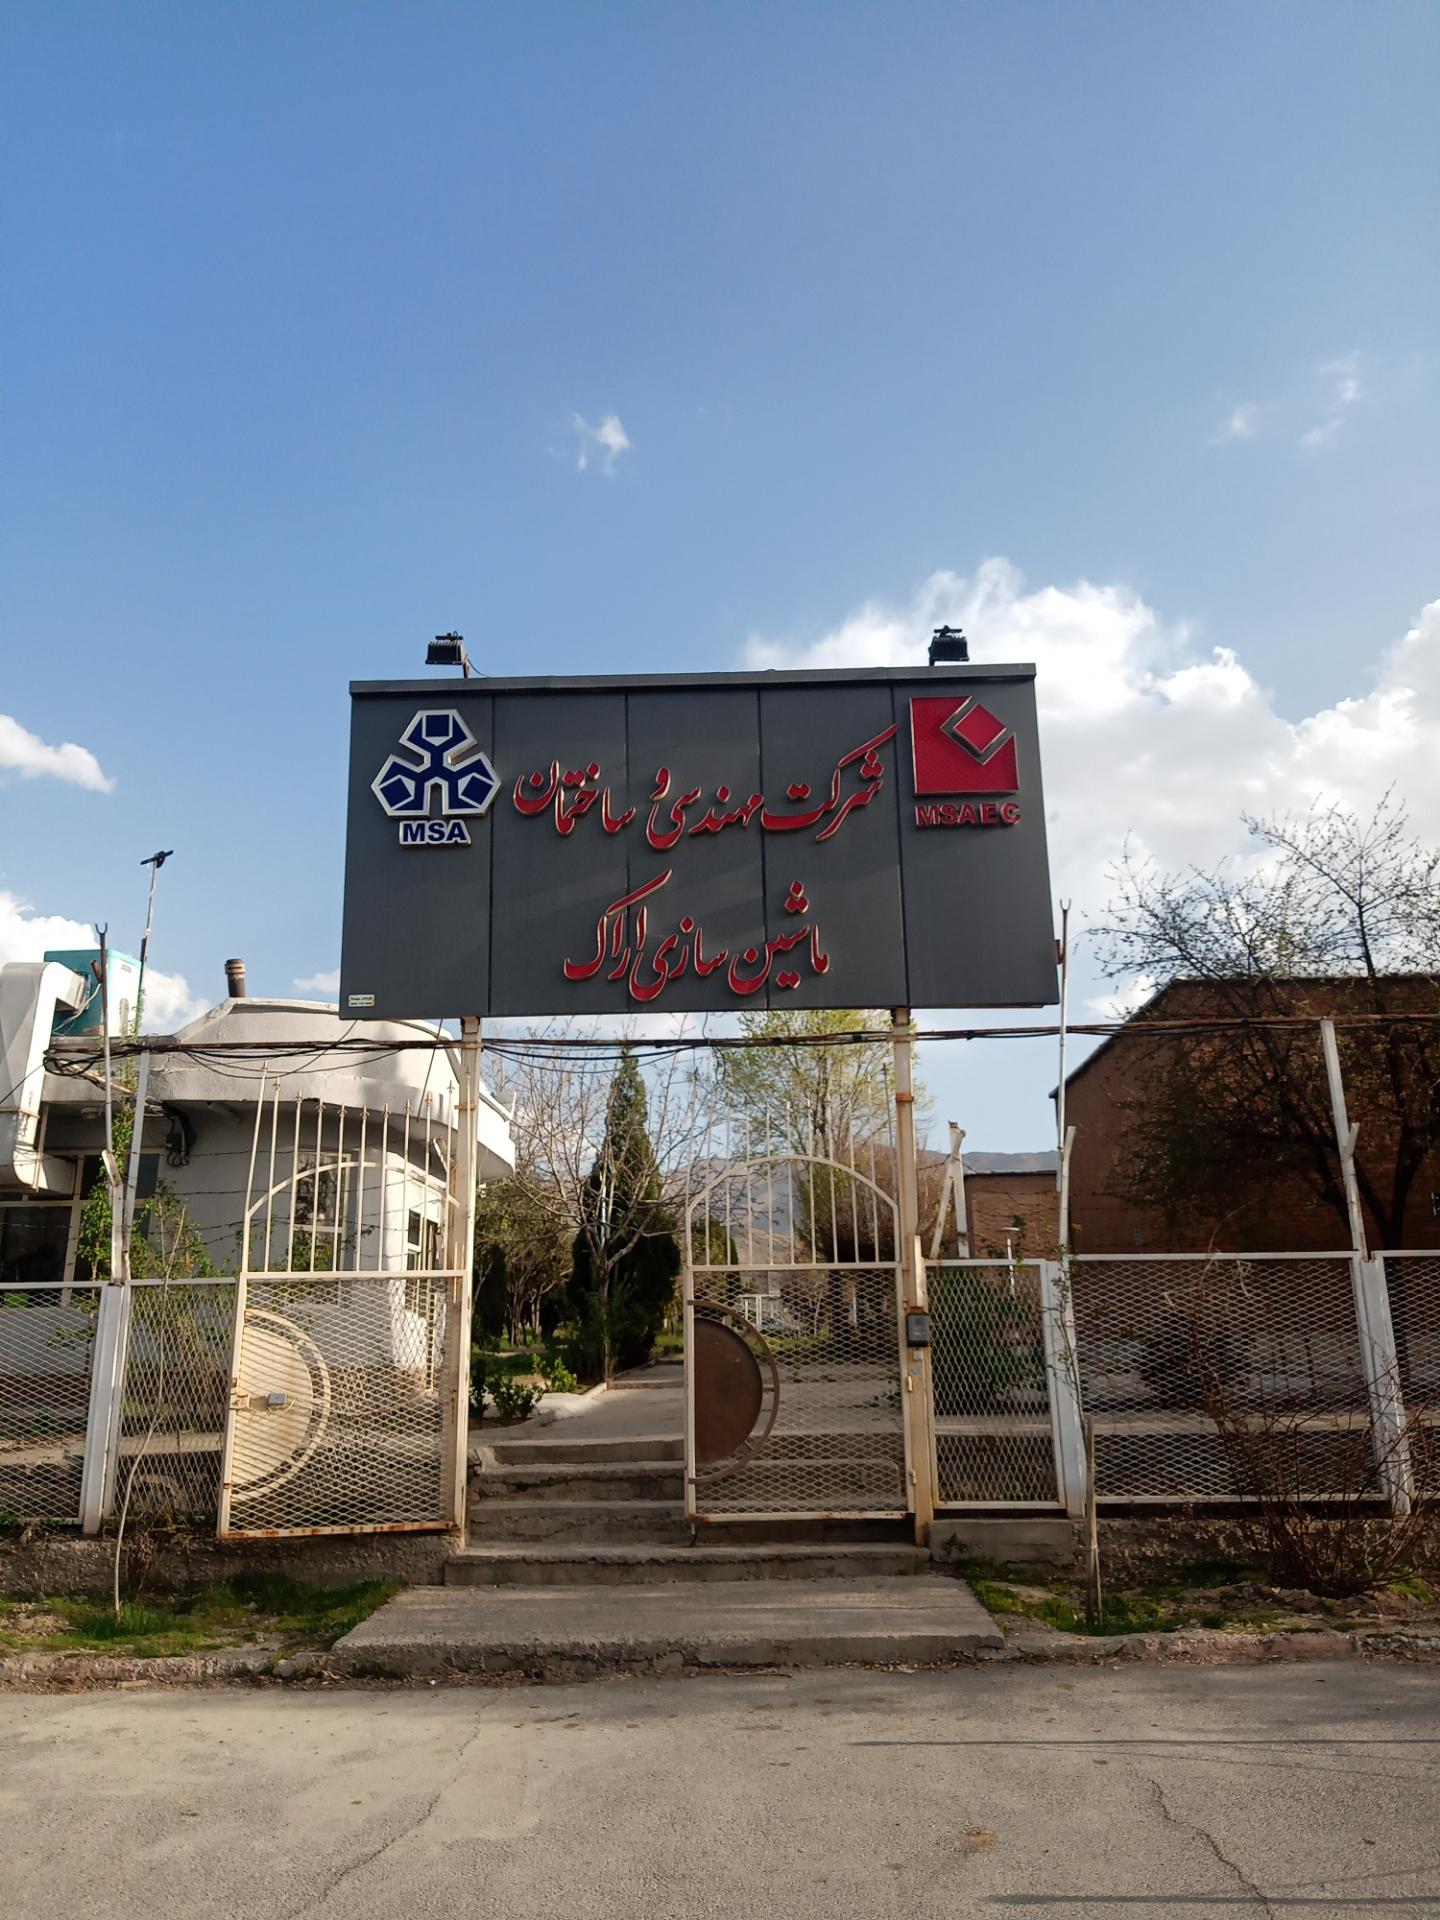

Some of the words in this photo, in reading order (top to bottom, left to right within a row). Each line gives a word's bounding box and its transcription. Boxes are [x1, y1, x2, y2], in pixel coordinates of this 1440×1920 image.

[513, 760, 637, 835] ساختمان
[646, 783, 764, 849] مهندسی
[650, 767, 671, 801] و
[761, 722, 898, 841] شرکت
[914, 802, 1021, 826] MSAEC
[399, 819, 471, 844] MSA
[564, 868, 672, 981] اراک
[629, 916, 728, 1001] سازی
[728, 880, 830, 995] ماشین
